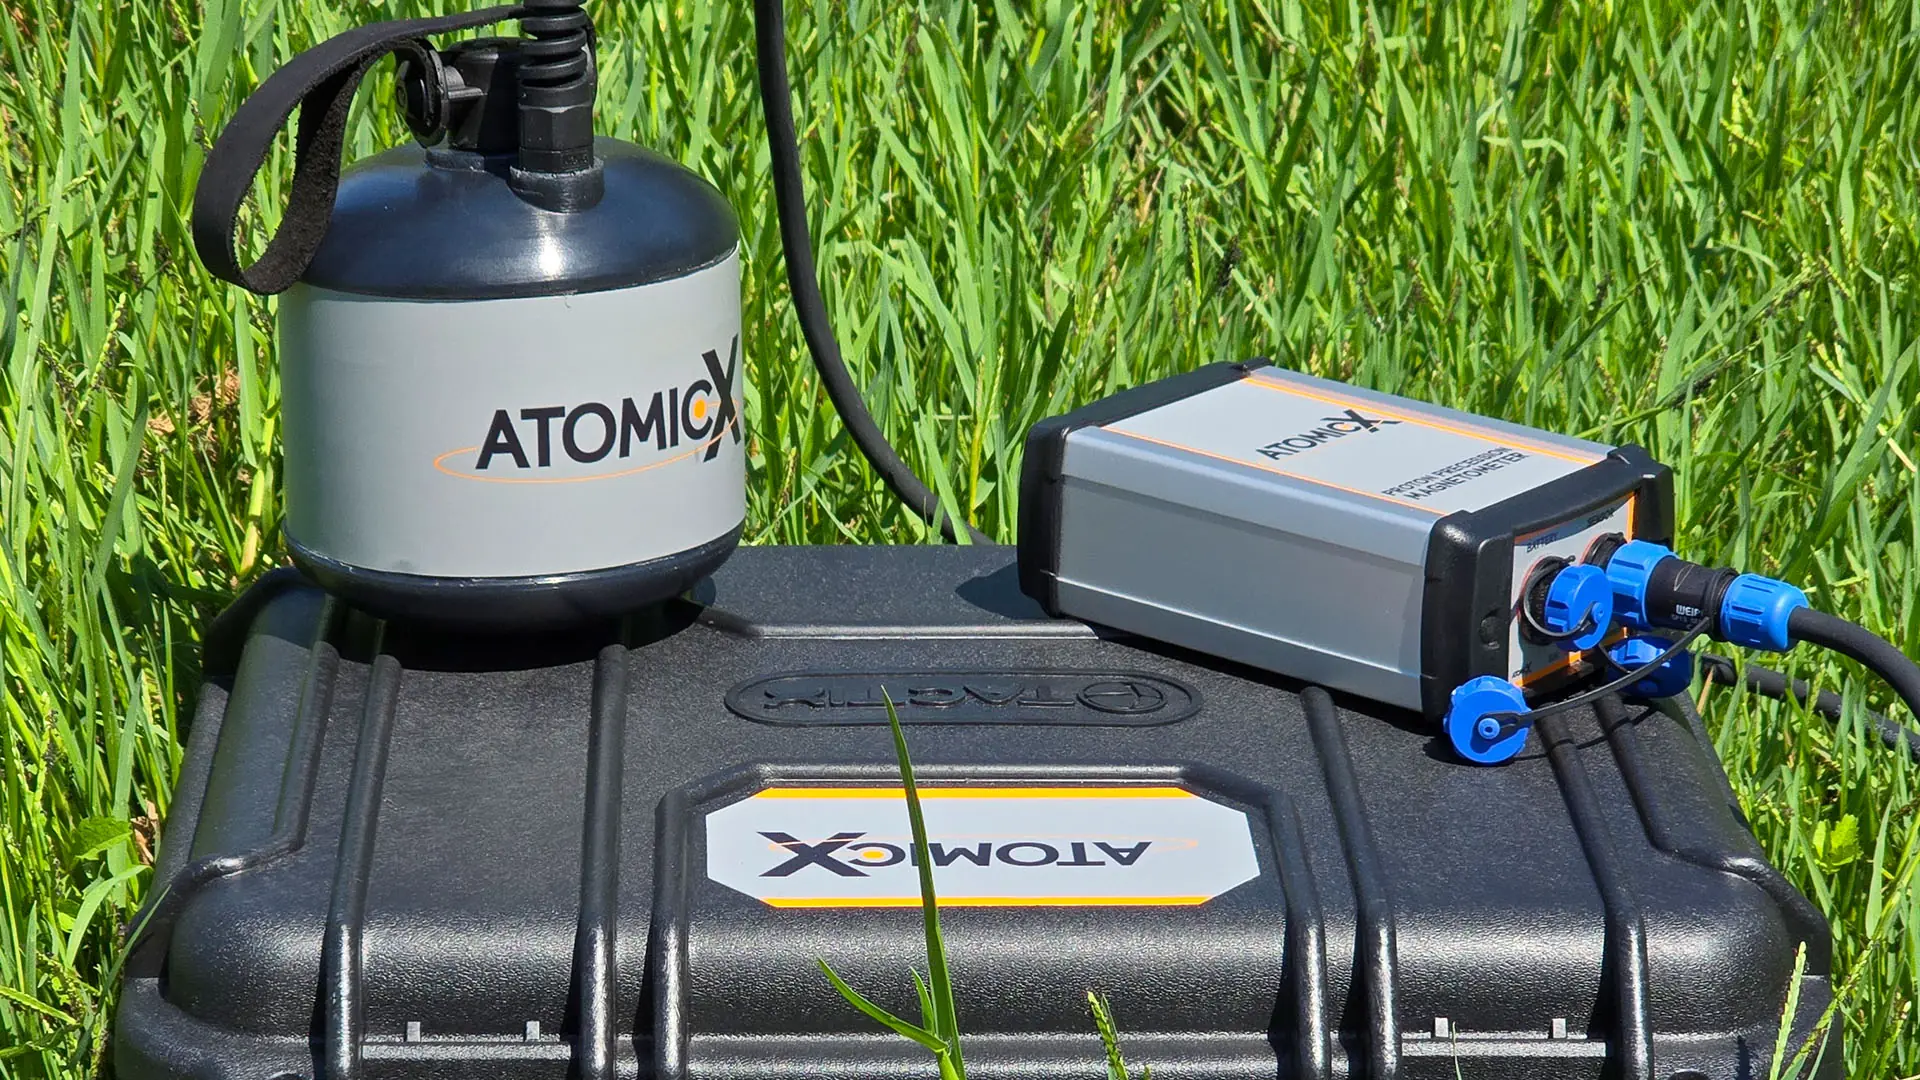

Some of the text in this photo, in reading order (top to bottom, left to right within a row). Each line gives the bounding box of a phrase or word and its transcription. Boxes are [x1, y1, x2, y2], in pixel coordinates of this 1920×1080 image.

[475, 333, 741, 469] ATOMICX
[1256, 408, 1403, 461] ATOMICX
[1381, 446, 1512, 497] PROTON PRECESSION
[1403, 451, 1529, 500] MAGNETOMETER
[1676, 604, 1704, 617] WEIP
